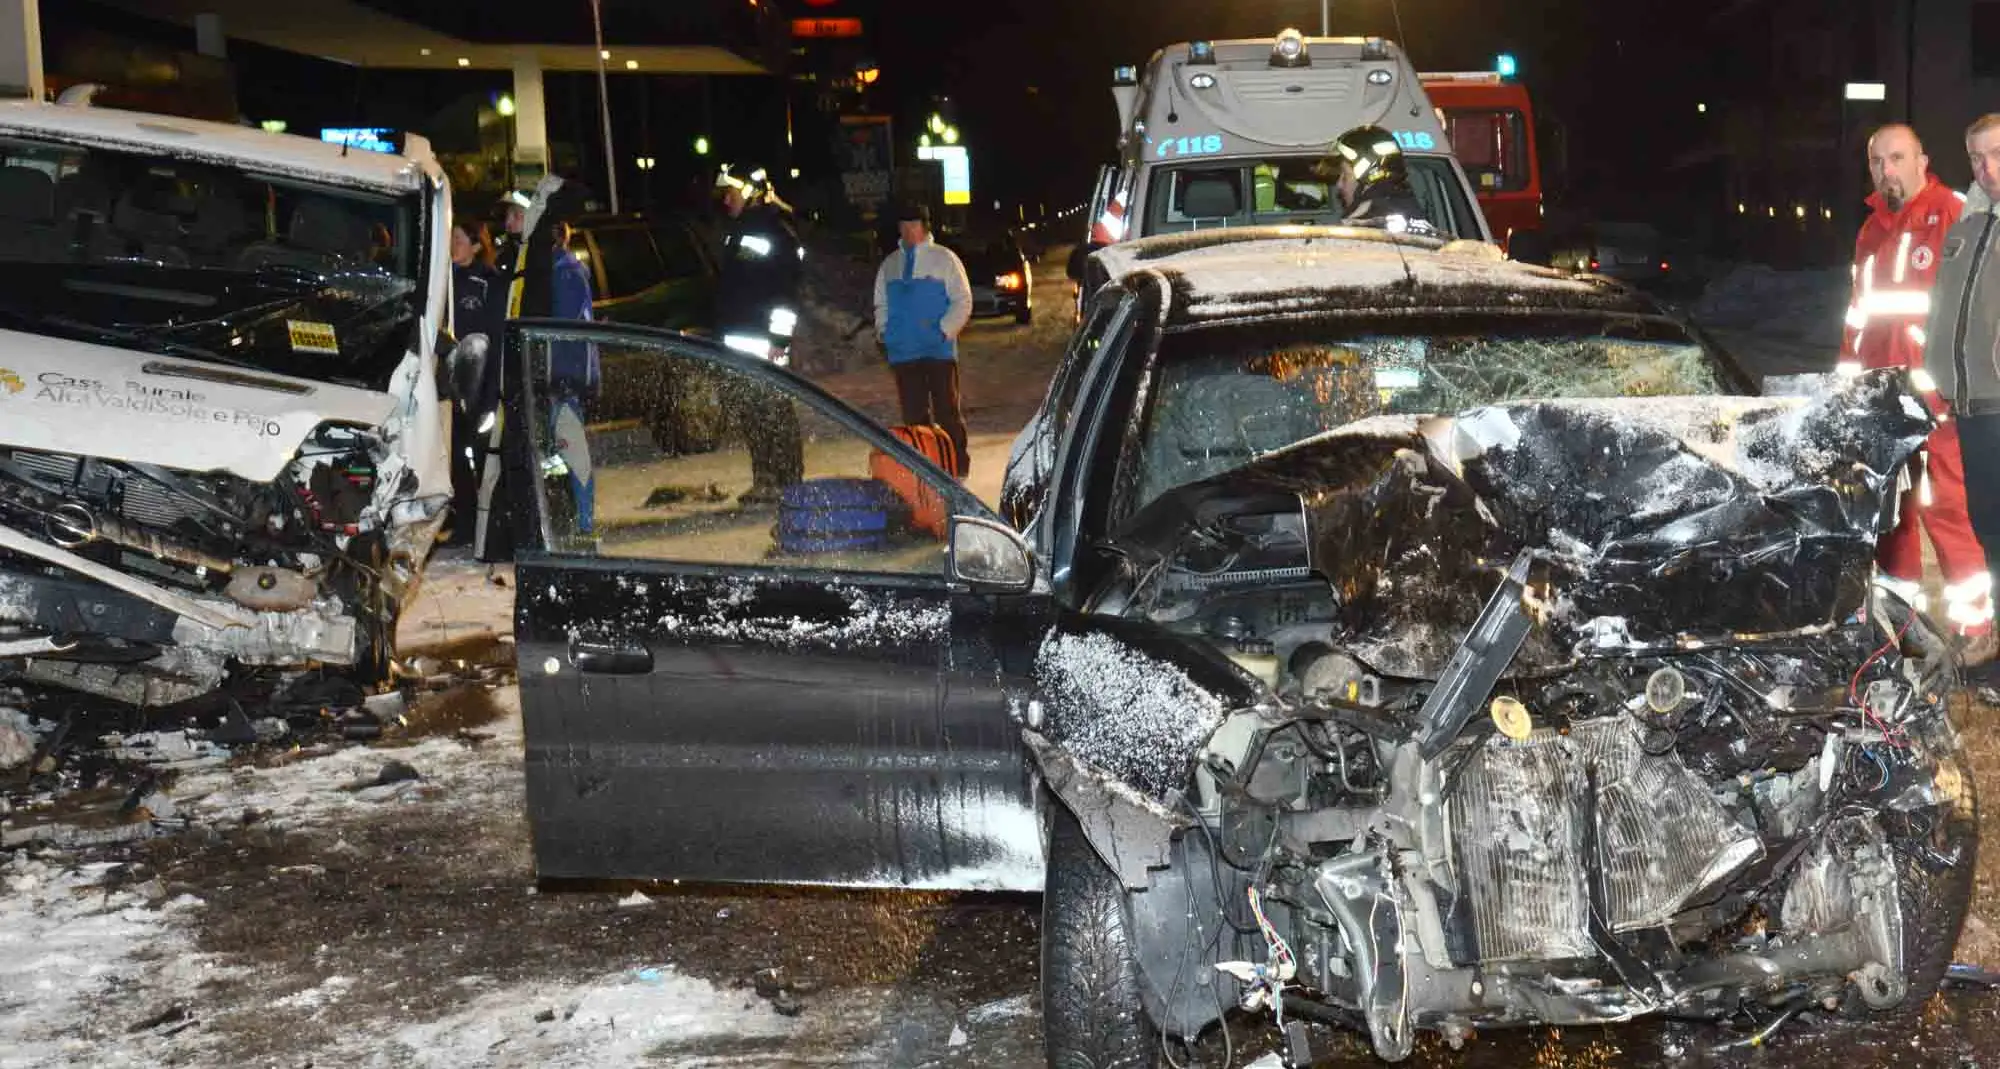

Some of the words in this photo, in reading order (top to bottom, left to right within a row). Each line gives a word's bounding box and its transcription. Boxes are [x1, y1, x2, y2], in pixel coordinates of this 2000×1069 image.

[1175, 134, 1223, 154] 118
[37, 372, 109, 390] Cass
[213, 411, 228, 423] e
